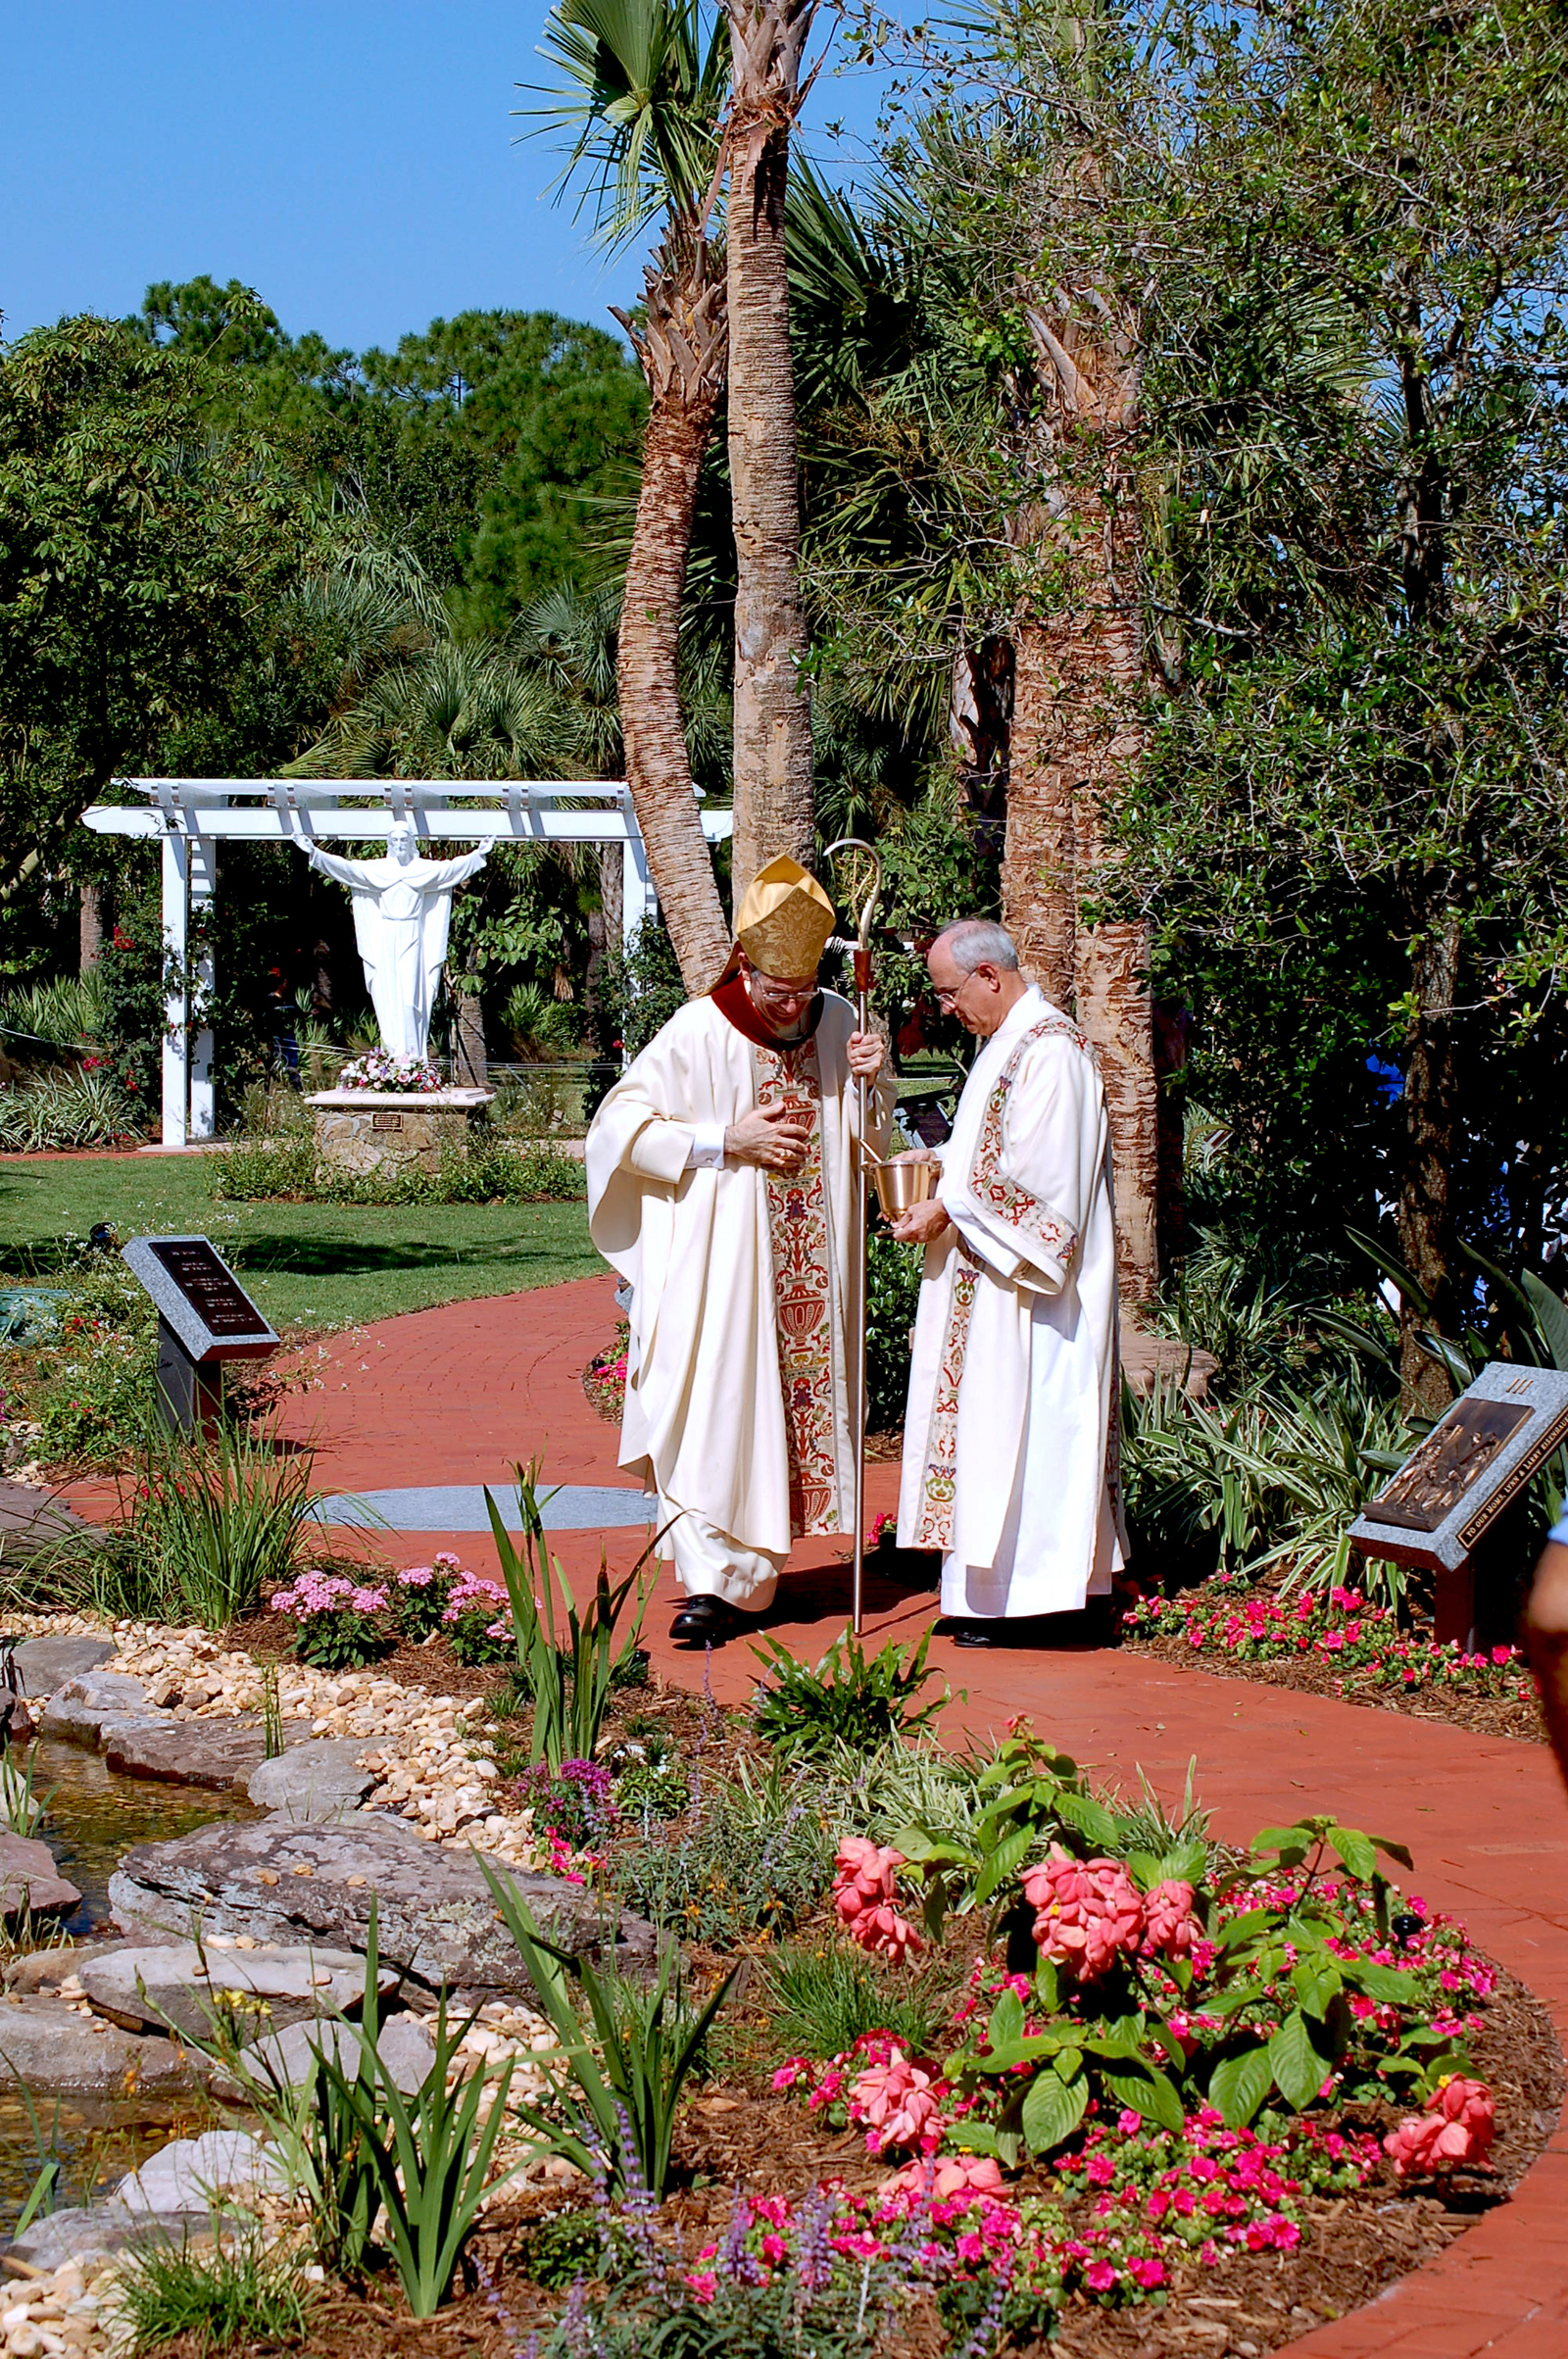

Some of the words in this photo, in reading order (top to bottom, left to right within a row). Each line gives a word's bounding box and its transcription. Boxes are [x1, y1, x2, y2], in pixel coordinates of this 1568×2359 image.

[1505, 1378, 1534, 1396] III
[1465, 1527, 1477, 1538] TO
[1475, 1512, 1489, 1528] OUR
[1486, 1494, 1507, 1514] MOMS,
[1503, 1475, 1520, 1494] LYNN
[1522, 1450, 1542, 1470] LARRY
[1540, 1413, 1568, 1450] EISENHAUE
